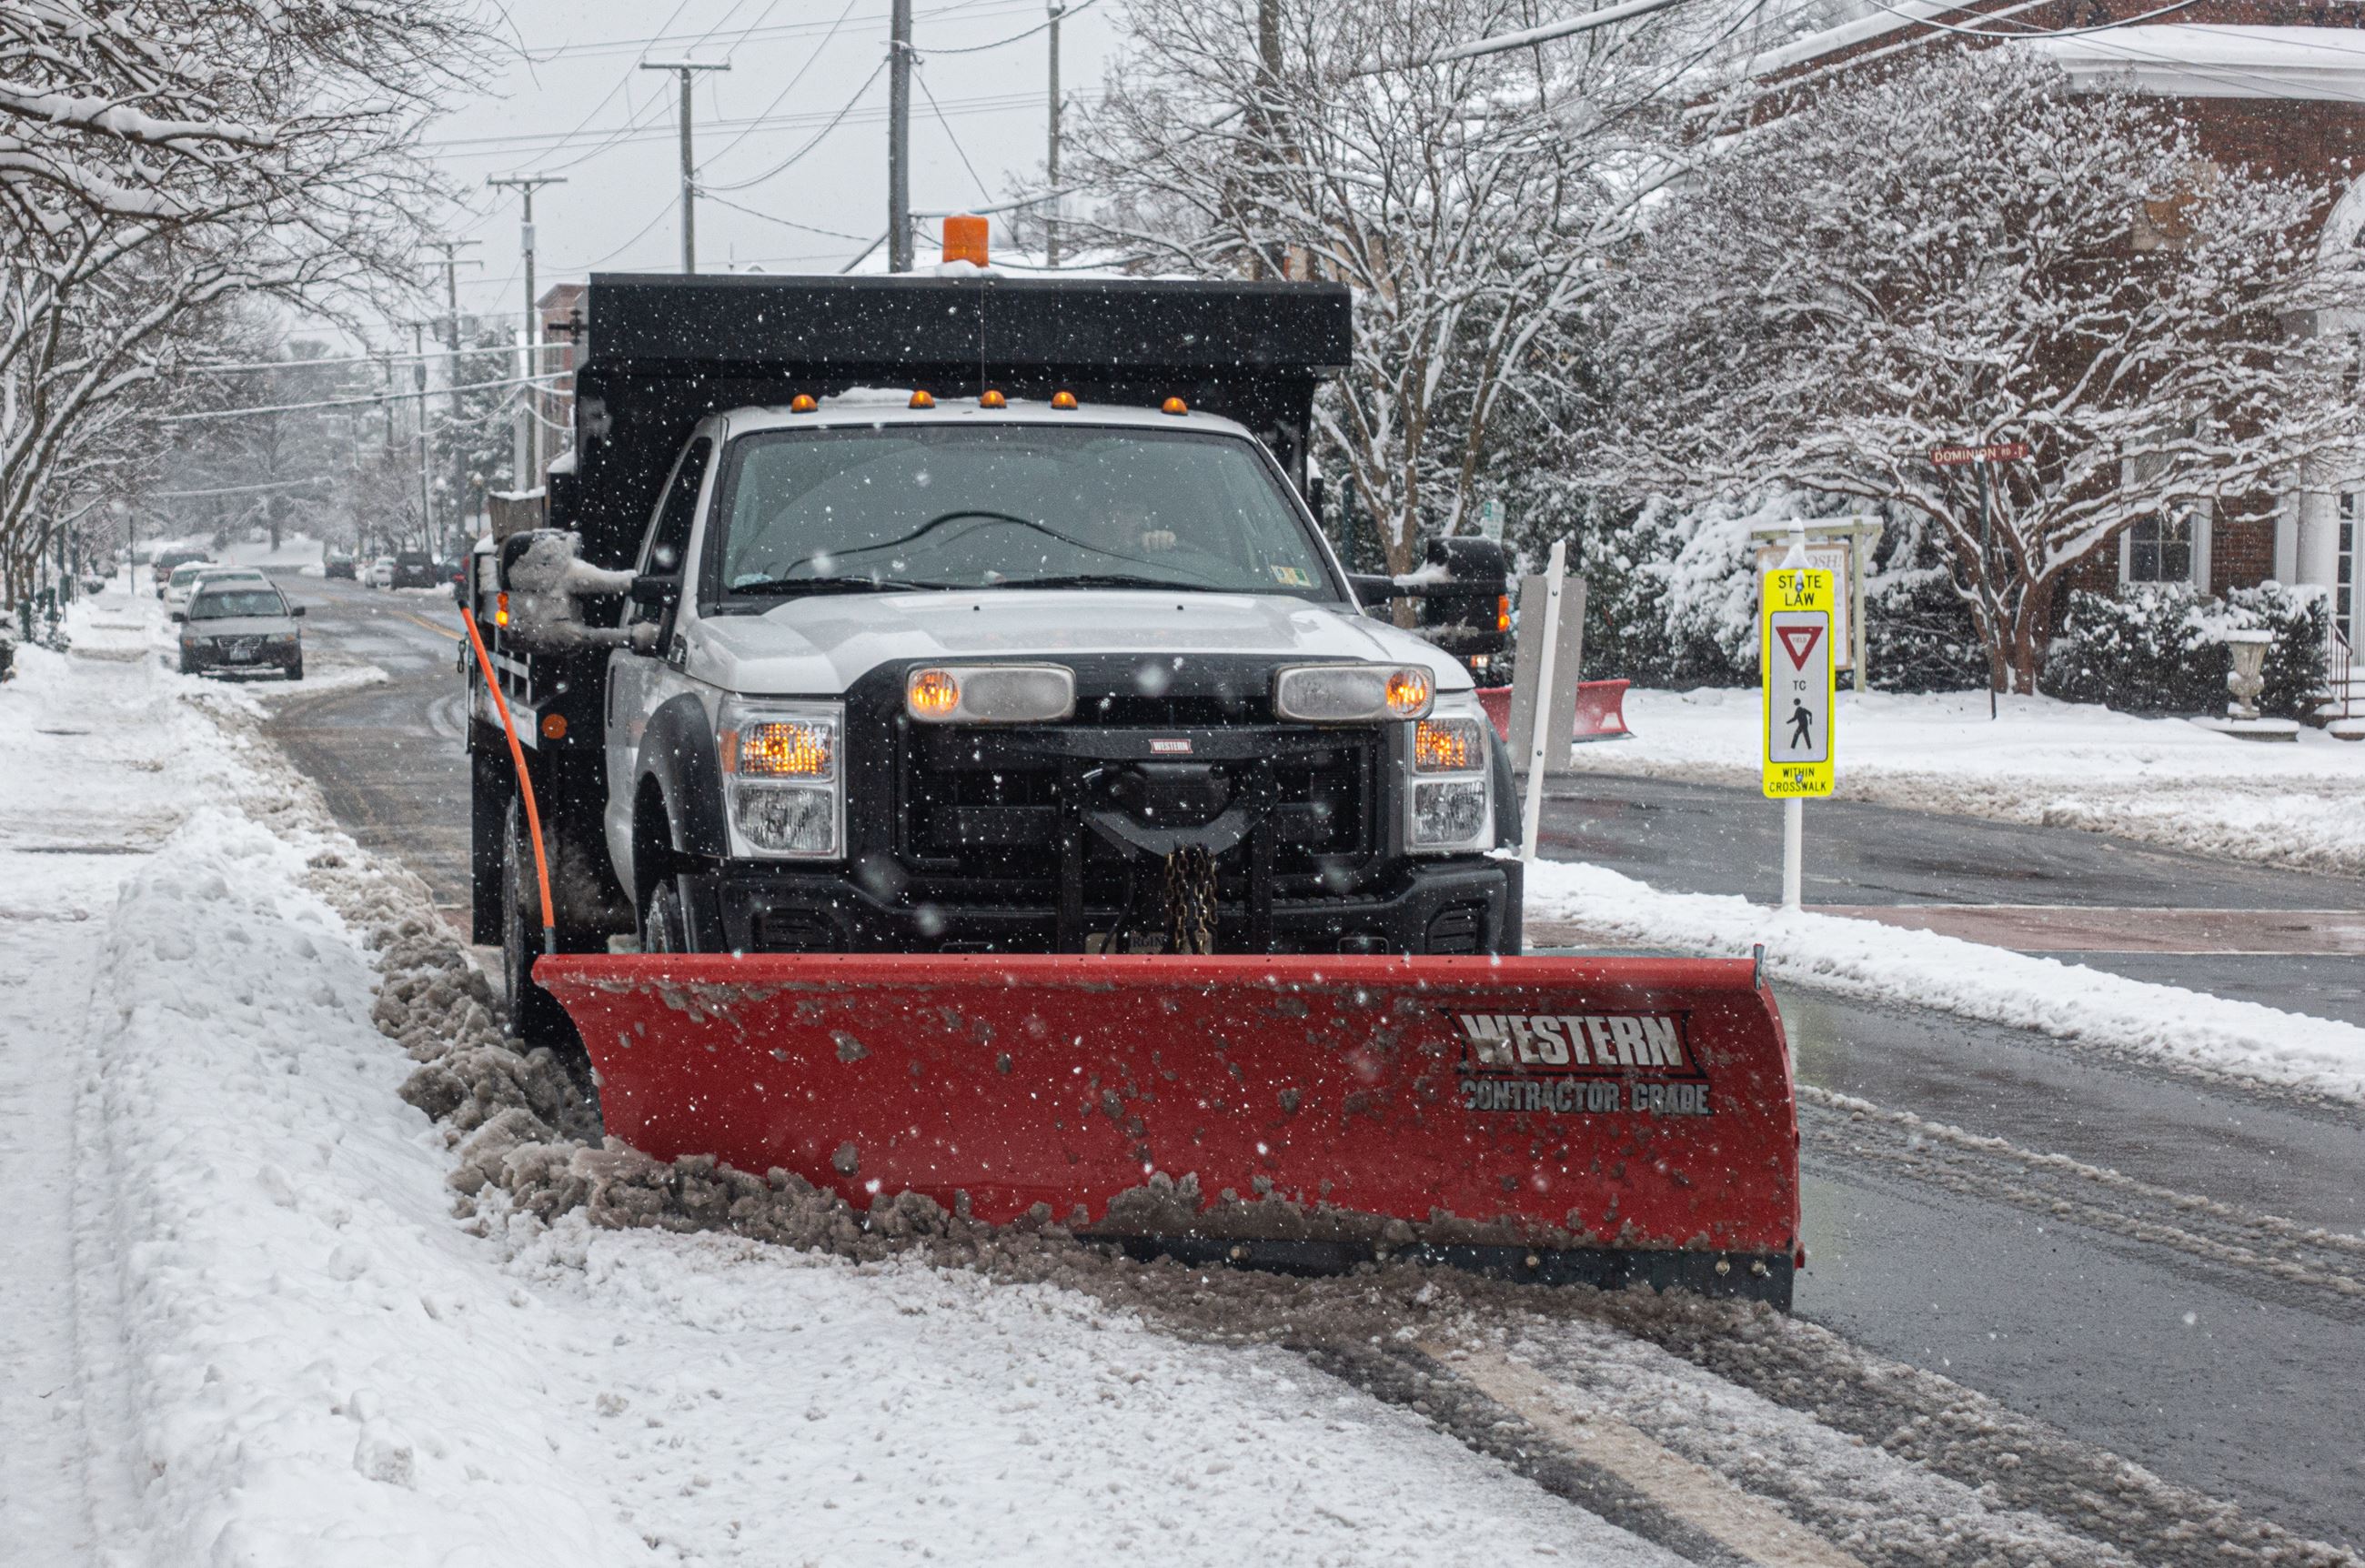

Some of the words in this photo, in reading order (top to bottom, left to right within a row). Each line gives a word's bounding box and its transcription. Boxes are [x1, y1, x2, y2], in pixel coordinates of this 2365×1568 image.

[1935, 447, 1997, 463] DOMINION
[1807, 554, 1842, 568] OSH!
[1785, 592, 1815, 607] LAW
[1152, 741, 1190, 751] WESTERN
[1782, 767, 1815, 778] WITHIN
[1769, 780, 1827, 793] CROSSWALK
[1460, 1014, 1683, 1066] WESTERN
[1461, 1080, 1620, 1112] CONTRACTOR
[1629, 1082, 1711, 1114] GRADE
